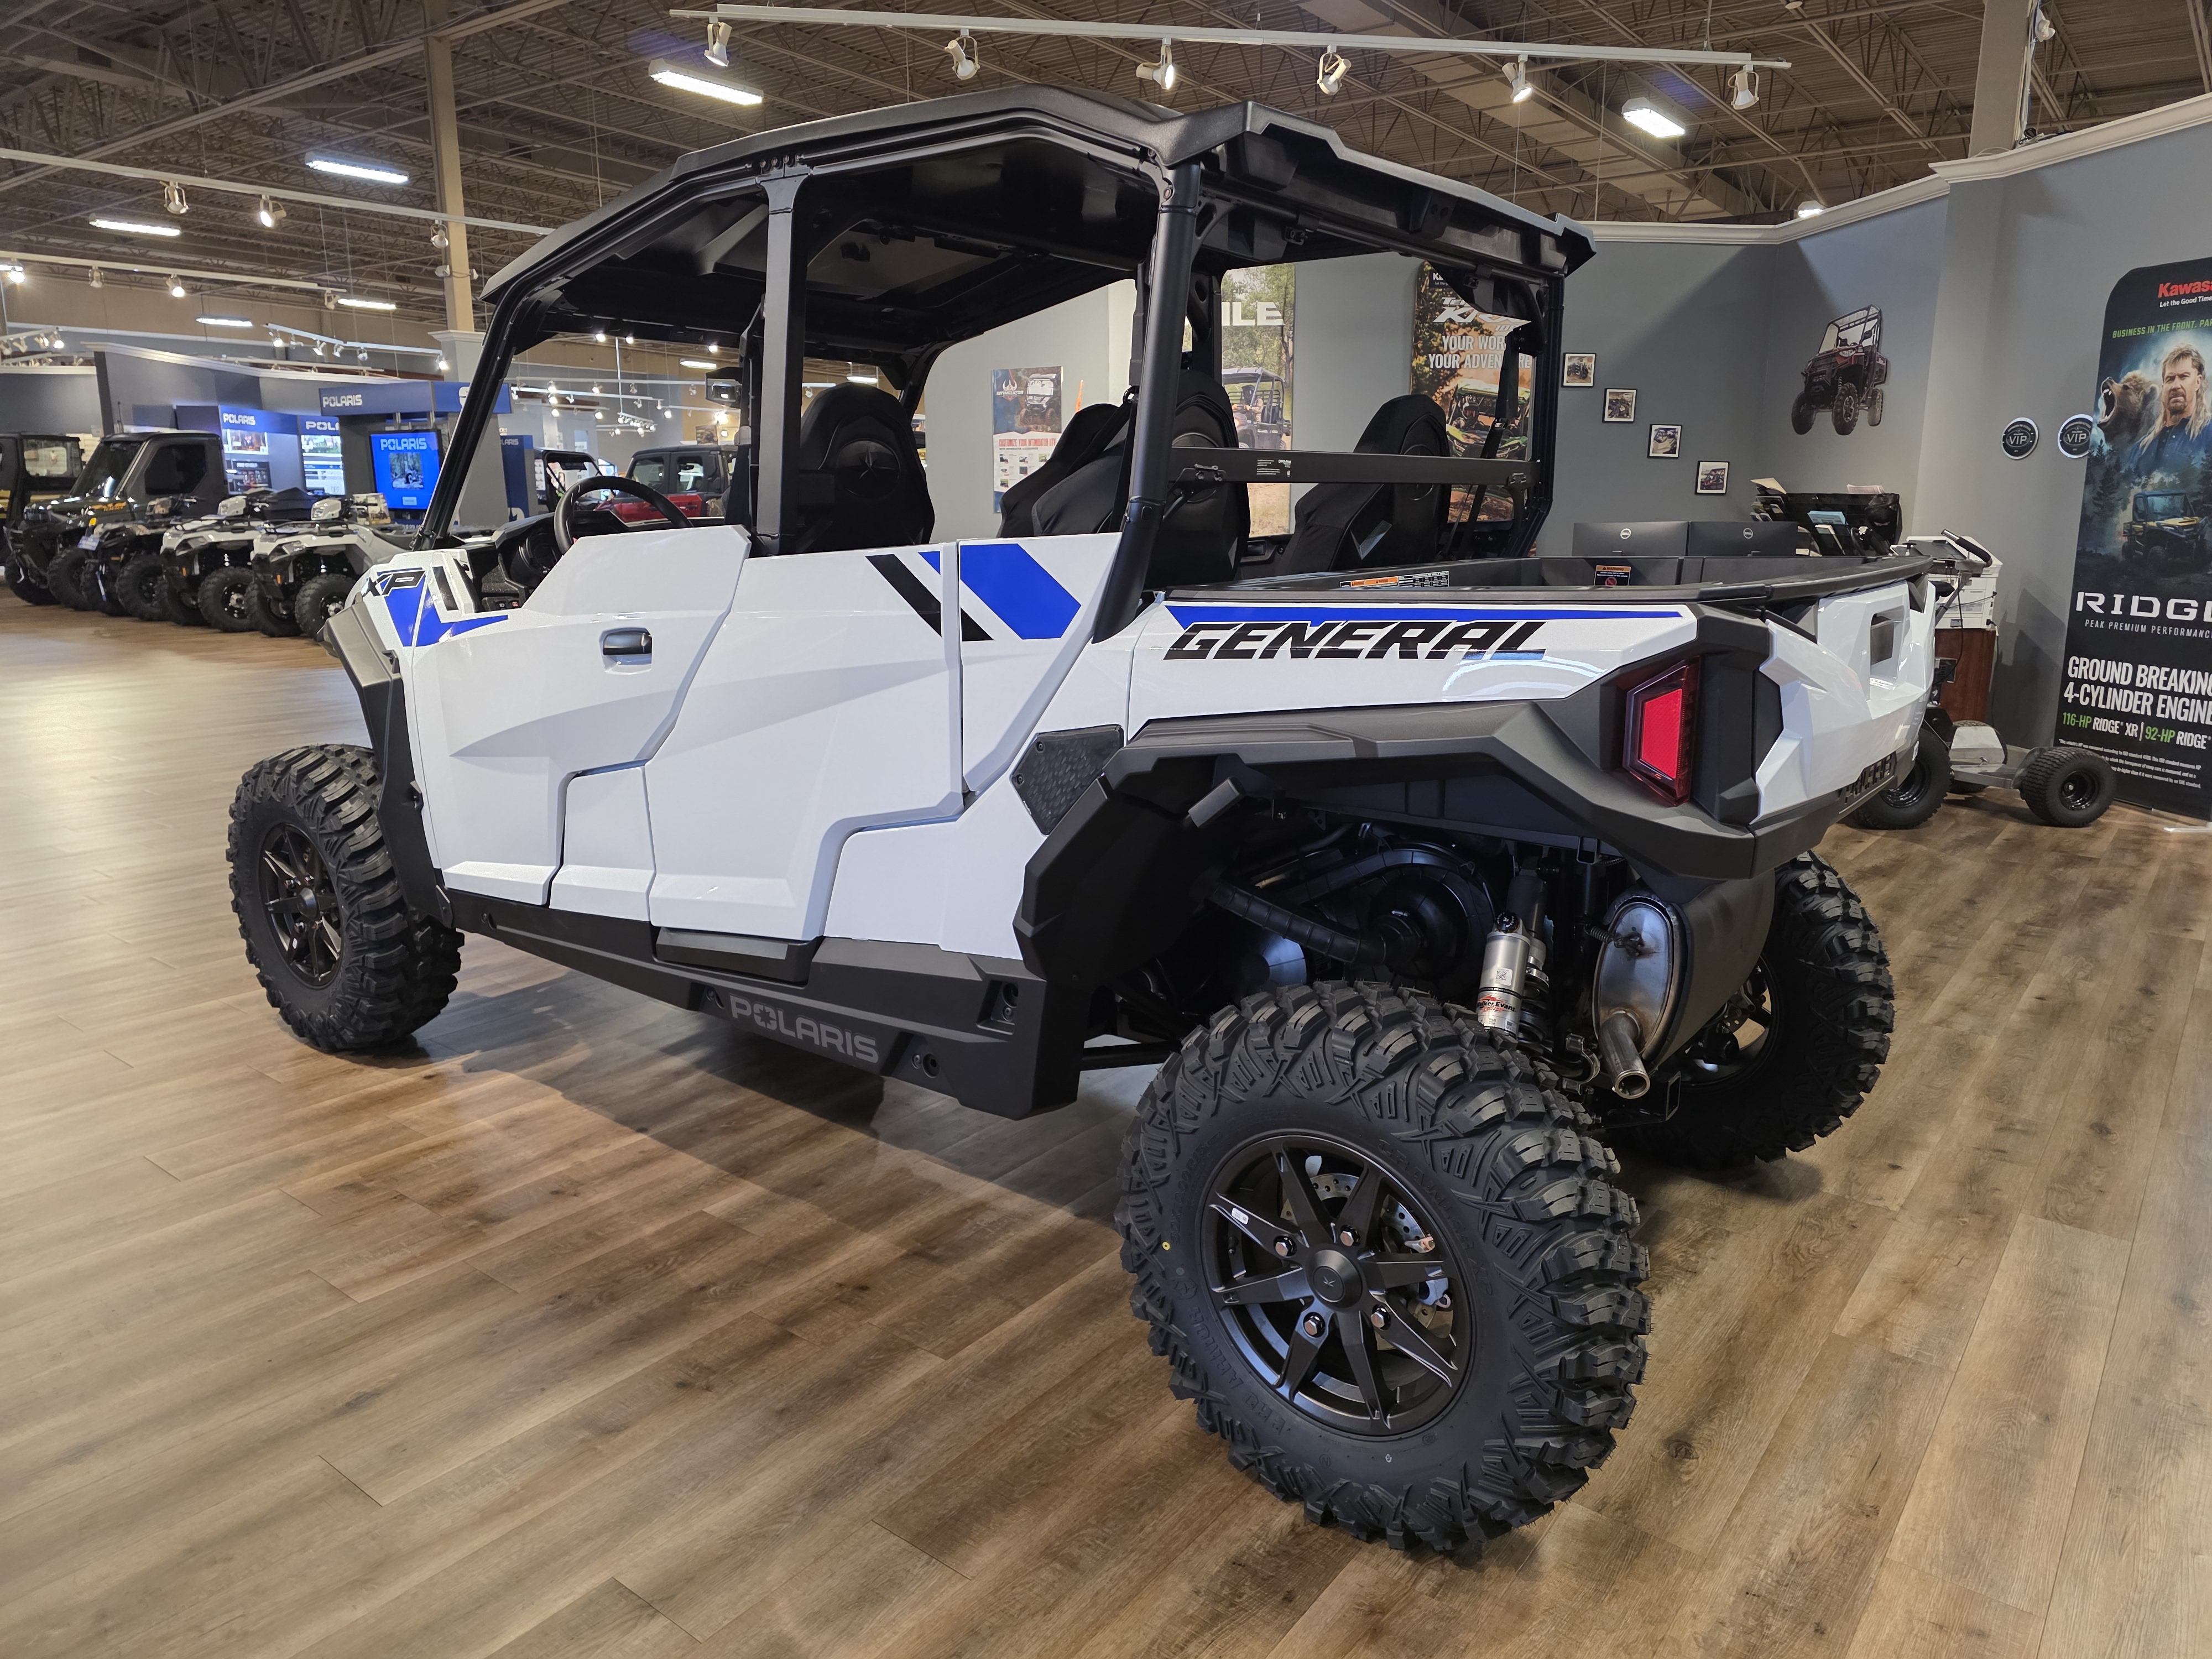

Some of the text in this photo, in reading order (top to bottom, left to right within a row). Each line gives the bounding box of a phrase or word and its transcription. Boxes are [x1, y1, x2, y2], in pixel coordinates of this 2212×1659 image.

[2158, 280, 2212, 298] Kawas
[1221, 301, 1286, 326] ILE
[2112, 327, 2146, 339] BUSINESS
[2147, 325, 2155, 333] IN
[2157, 324, 2170, 332] THE
[2172, 321, 2197, 331] FRONT.
[1442, 335, 1506, 351] YOUR WOR
[1428, 353, 1531, 369] YOUR ADVENRE
[323, 394, 363, 408] POLARIS
[223, 413, 255, 425] POLARIS
[380, 437, 427, 451] POLARIS
[2009, 435, 2027, 445] VIP
[2067, 433, 2086, 443] VIP
[362, 571, 426, 597] XP
[2076, 591, 2212, 622] RIDG
[2085, 619, 2212, 639] PEAK PREMIUM PERFORMANC
[1163, 620, 1547, 661] GENERAL
[2068, 656, 2133, 685] GROUND
[2064, 681, 2154, 716] 4-CYLINDER
[2063, 712, 2092, 728] 116-HP
[2125, 722, 2138, 738] XR
[2145, 726, 2176, 743] 92-HP
[1495, 1001, 1516, 1012] Evans
[729, 994, 879, 1064] POLARIS
